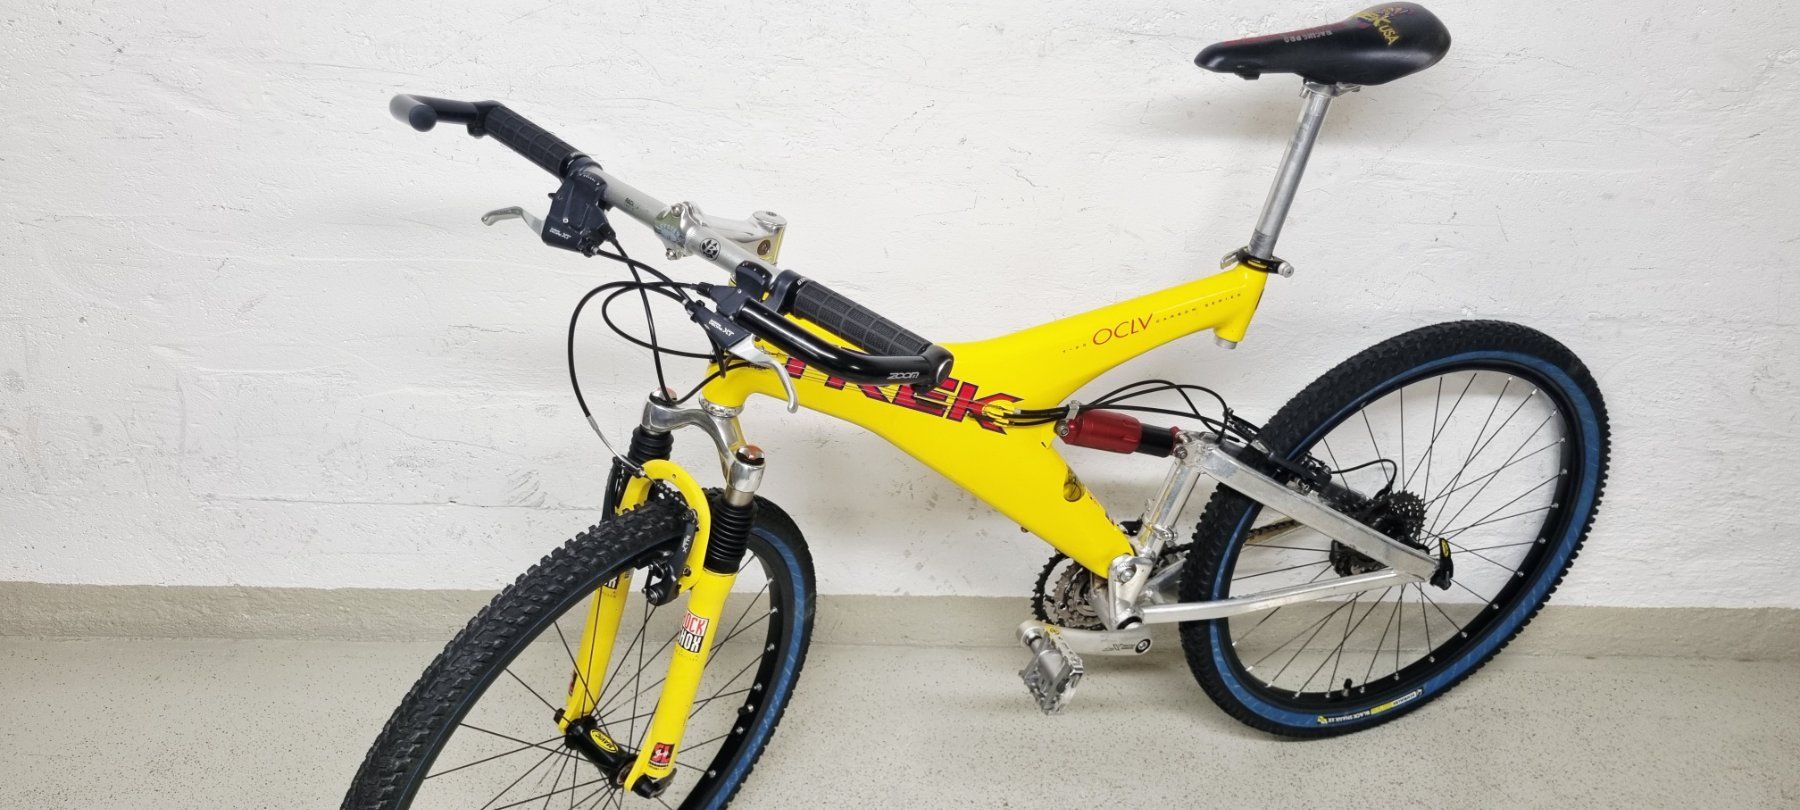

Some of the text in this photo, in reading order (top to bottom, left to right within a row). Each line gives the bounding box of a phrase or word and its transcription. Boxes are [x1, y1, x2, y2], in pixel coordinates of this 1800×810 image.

[1284, 35, 1302, 43] PRO
[1379, 25, 1399, 45] USA
[1092, 313, 1153, 345] OCLV
[887, 371, 920, 380] ZOOM
[684, 612, 706, 635] OCK
[678, 627, 702, 652] HOX
